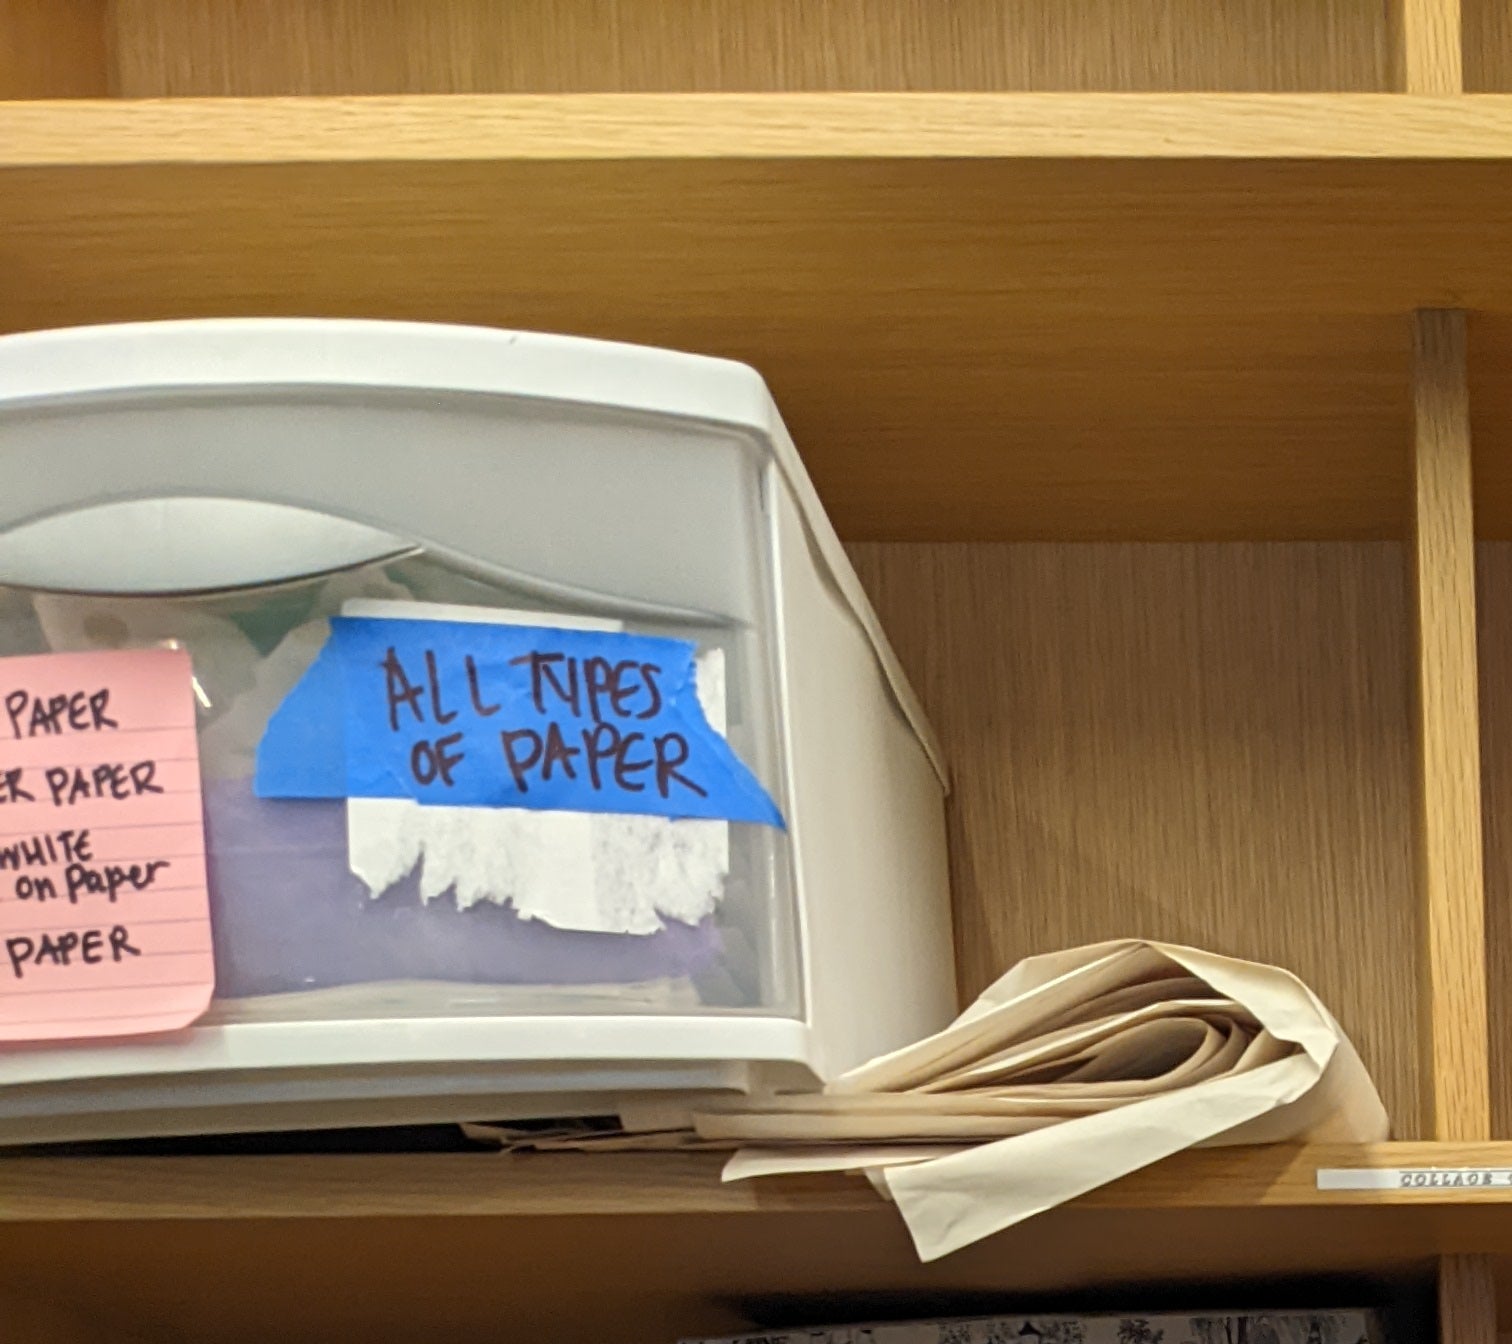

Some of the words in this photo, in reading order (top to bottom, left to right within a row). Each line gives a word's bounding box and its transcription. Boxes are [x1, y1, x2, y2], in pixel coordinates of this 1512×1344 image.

[6, 688, 118, 739] PAPER
[380, 646, 501, 731] ALL
[509, 650, 661, 724] TYPES
[46, 760, 164, 806] PAPER
[411, 732, 465, 787] OF
[502, 722, 708, 799] PAPER
[15, 875, 58, 901] on
[65, 861, 171, 904] Paper
[5, 924, 141, 978] PAPER
